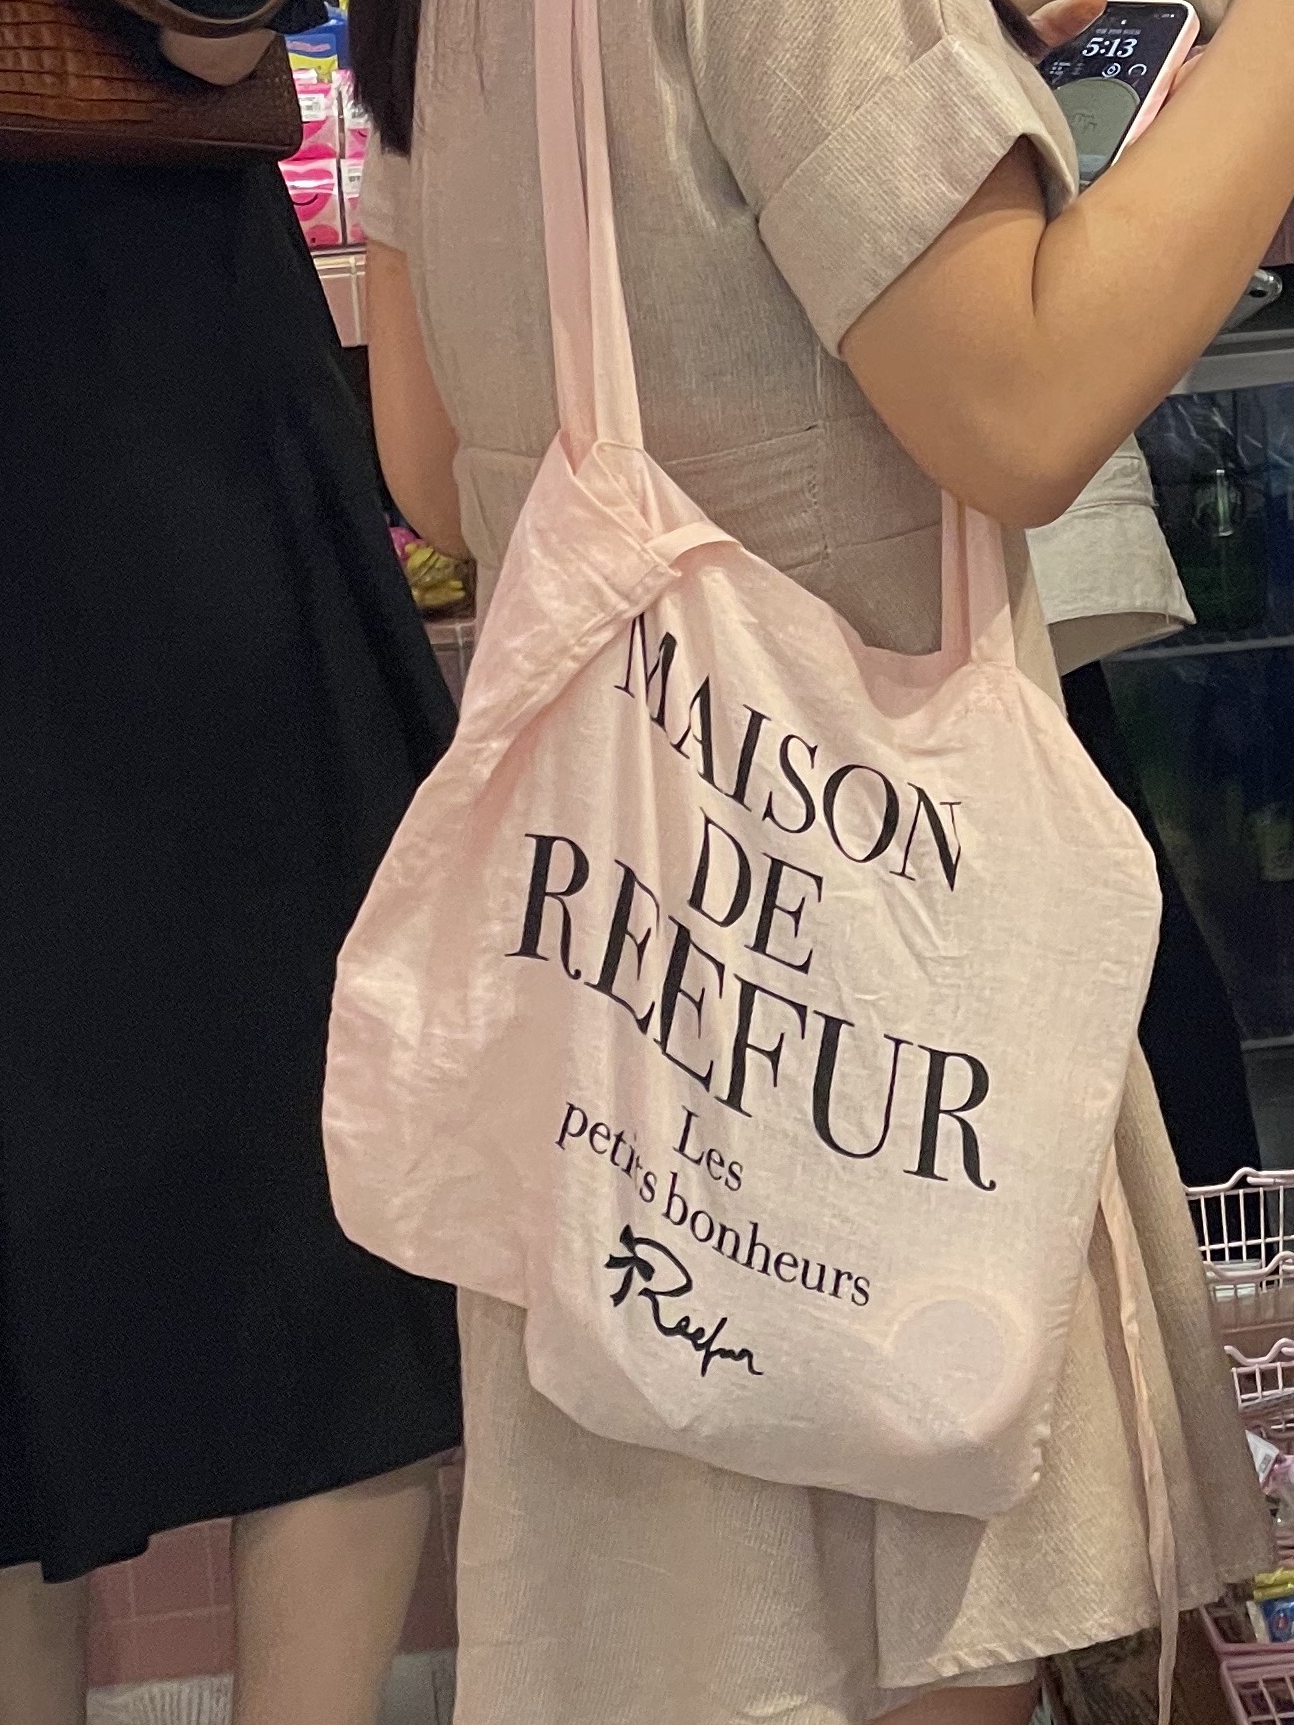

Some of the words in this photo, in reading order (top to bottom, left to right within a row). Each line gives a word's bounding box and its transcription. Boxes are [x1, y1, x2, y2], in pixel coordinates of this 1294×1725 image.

[1082, 37, 1138, 58] 5:13
[614, 614, 963, 892] MAISON
[687, 807, 824, 975] DE
[504, 832, 997, 1192] REEFUR
[673, 1105, 743, 1191] Les
[661, 1171, 871, 1307] bonheurs
